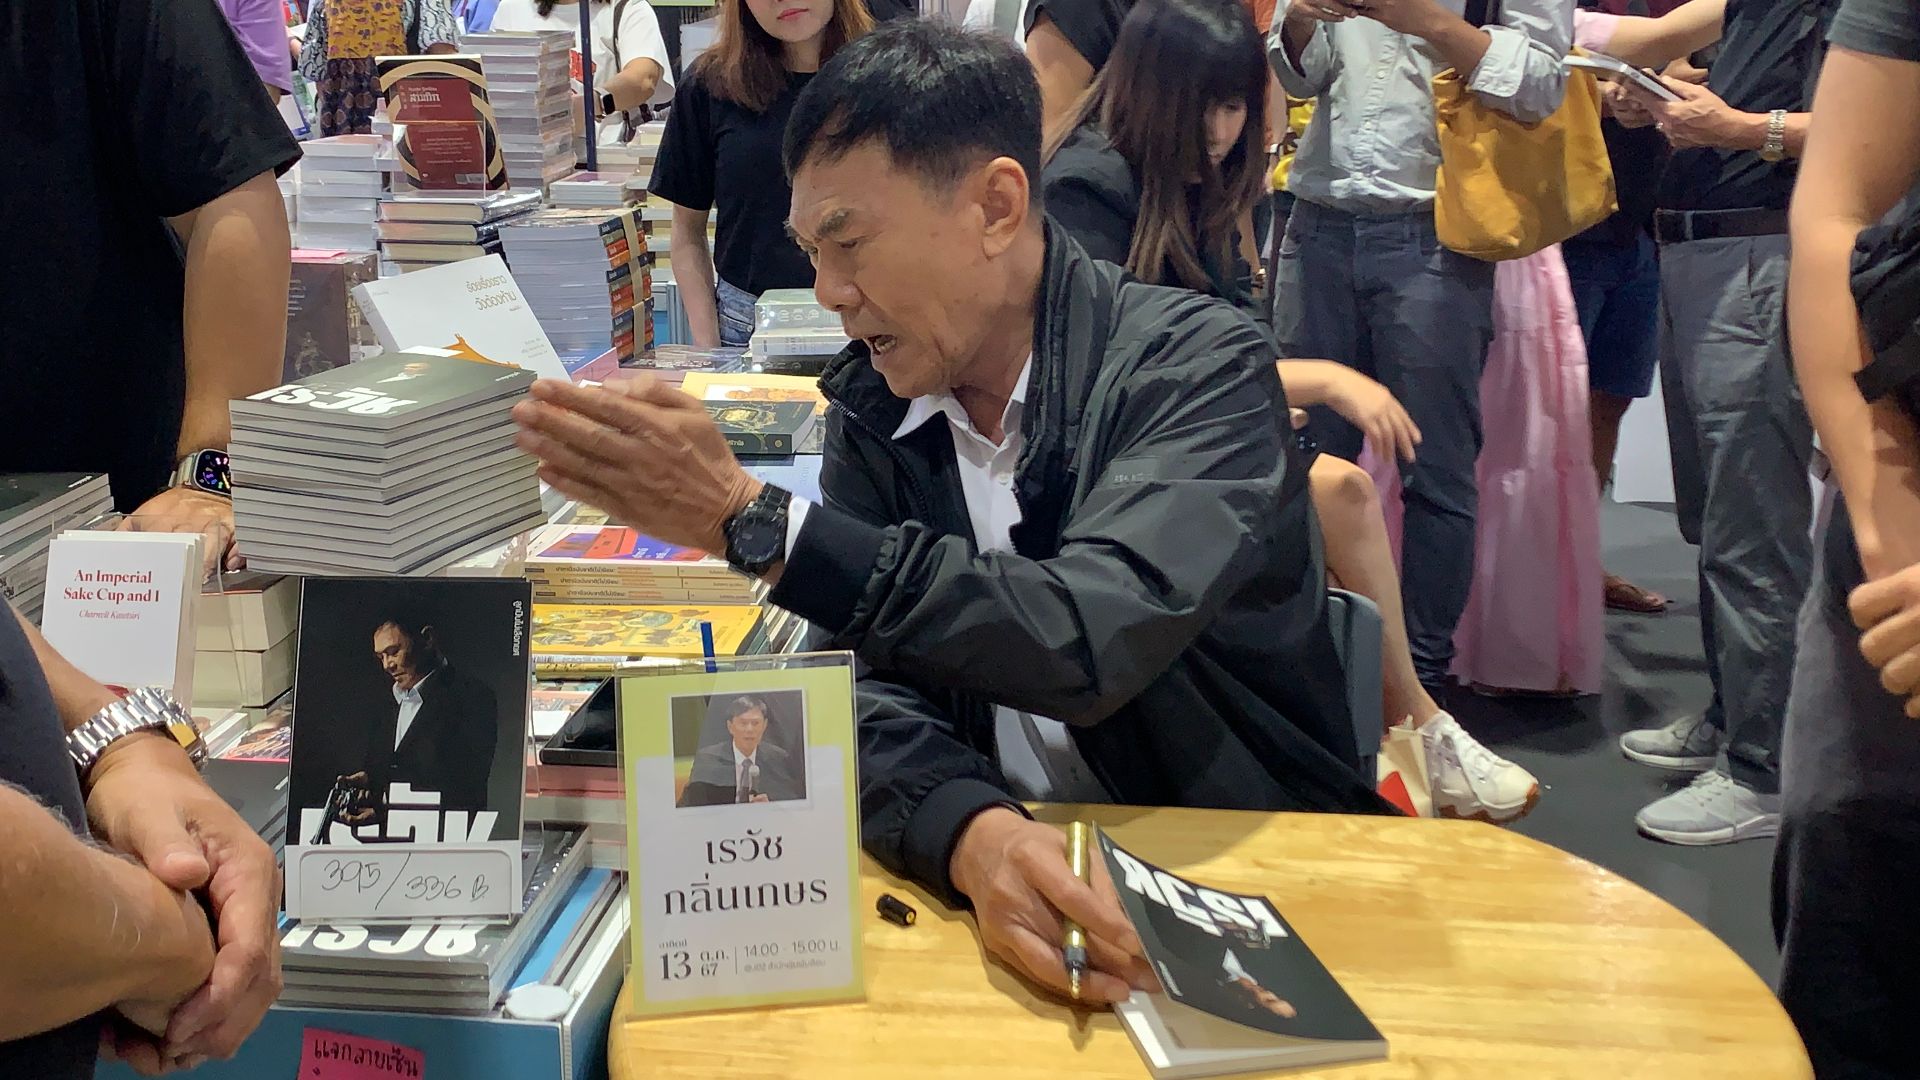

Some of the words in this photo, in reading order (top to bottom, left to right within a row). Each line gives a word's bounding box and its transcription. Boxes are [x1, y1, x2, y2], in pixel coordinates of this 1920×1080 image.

[74, 570, 93, 582] An
[96, 570, 152, 586] Imperial
[63, 587, 94, 600] Sake
[96, 588, 125, 605] Cup
[127, 589, 152, 602] and
[155, 590, 160, 602] I
[705, 828, 783, 865] เรวัช
[663, 872, 828, 915] กลิ่นเกษร
[744, 943, 780, 958] 14.00
[792, 939, 827, 954] 15.00
[660, 950, 692, 981] 13
[700, 962, 719, 978] 67
